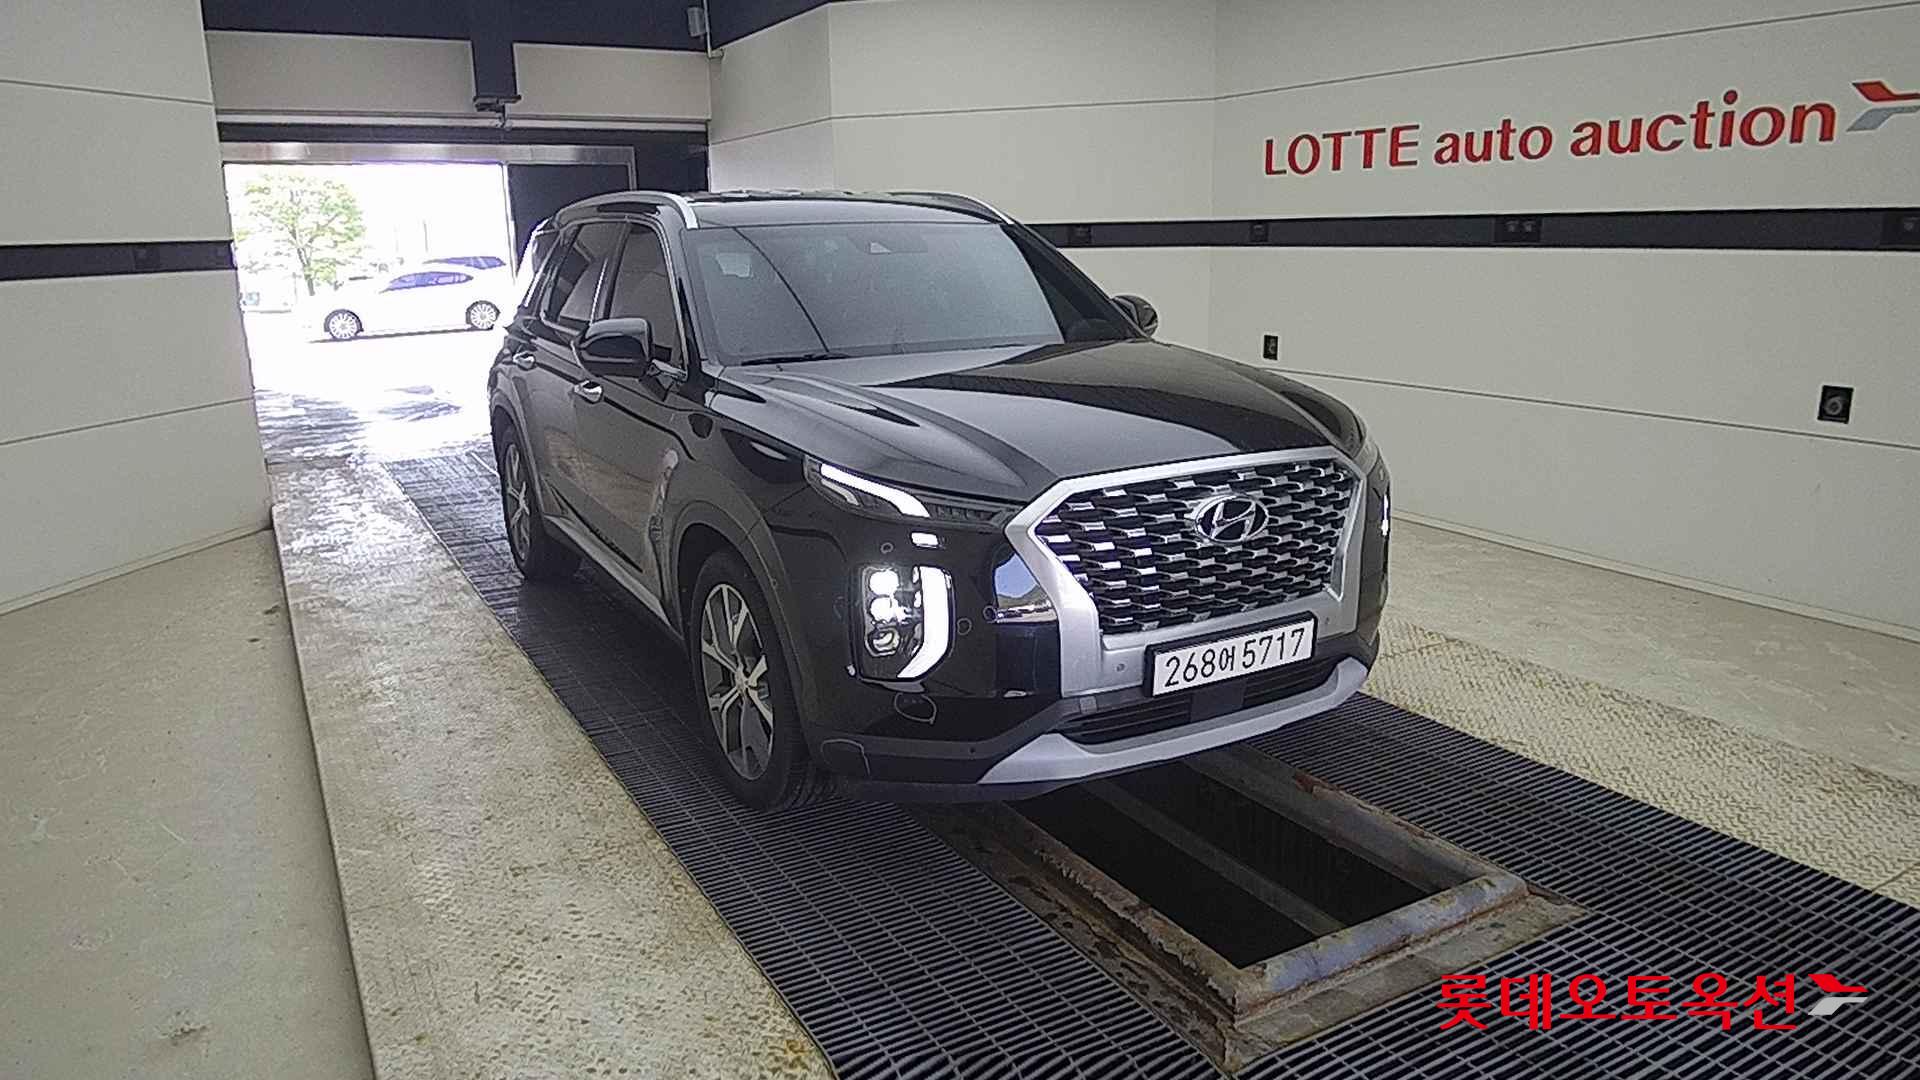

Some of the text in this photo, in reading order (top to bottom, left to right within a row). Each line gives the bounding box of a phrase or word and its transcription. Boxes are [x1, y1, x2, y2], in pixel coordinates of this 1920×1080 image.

[1264, 90, 1837, 176] LOTTE auto auction
[1164, 627, 1306, 688] 268어 5717
